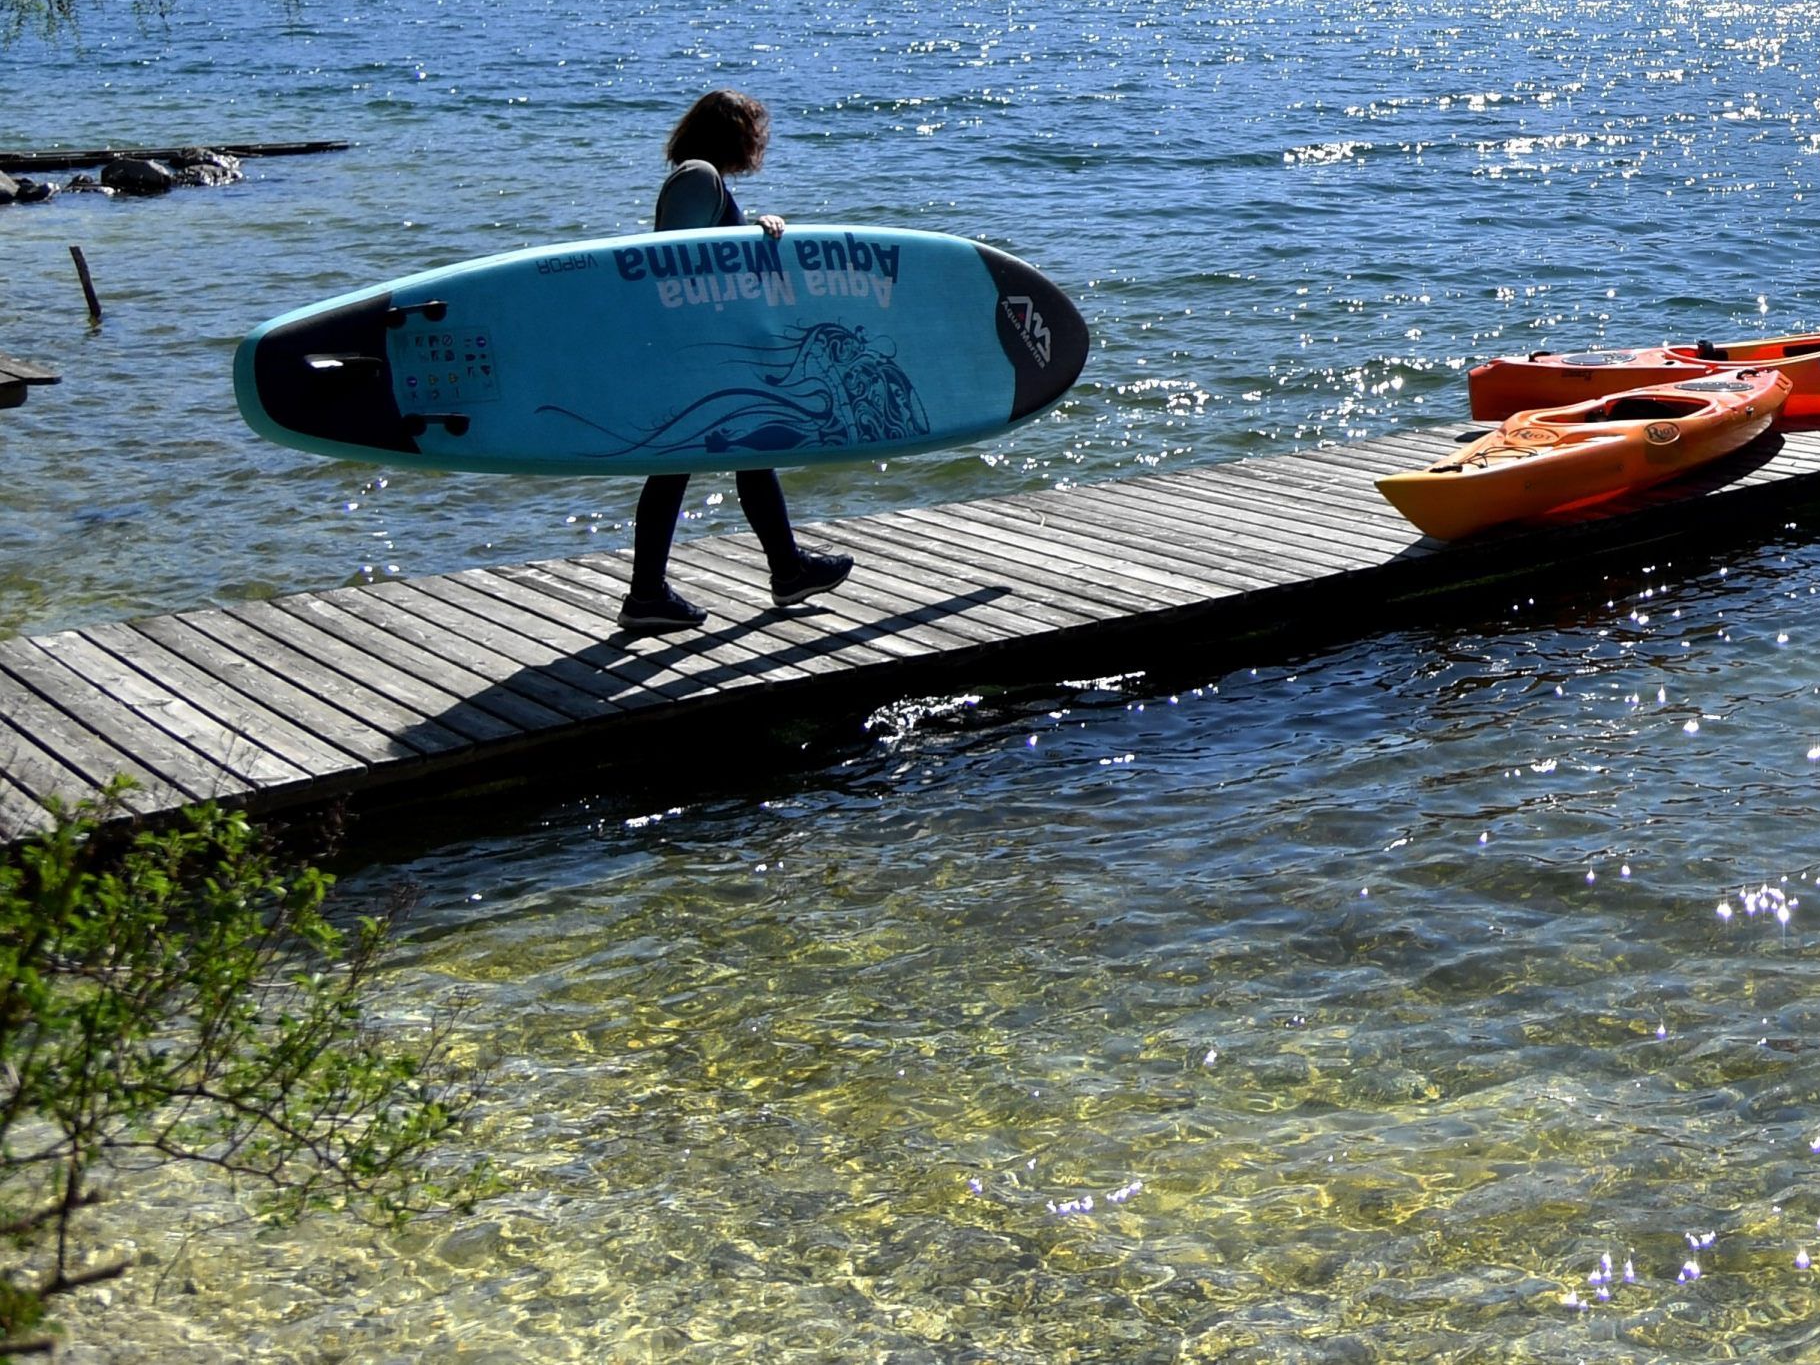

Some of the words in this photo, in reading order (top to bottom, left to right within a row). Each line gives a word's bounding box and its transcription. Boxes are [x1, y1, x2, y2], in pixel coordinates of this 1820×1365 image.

[536, 255, 598, 275] VAPOR
[613, 239, 785, 285] Marina
[793, 232, 900, 283] Aqua
[656, 269, 796, 312] Marina
[804, 262, 893, 308] Aqua
[1001, 300, 1021, 331] Aqua
[1020, 329, 1046, 369] Marina
